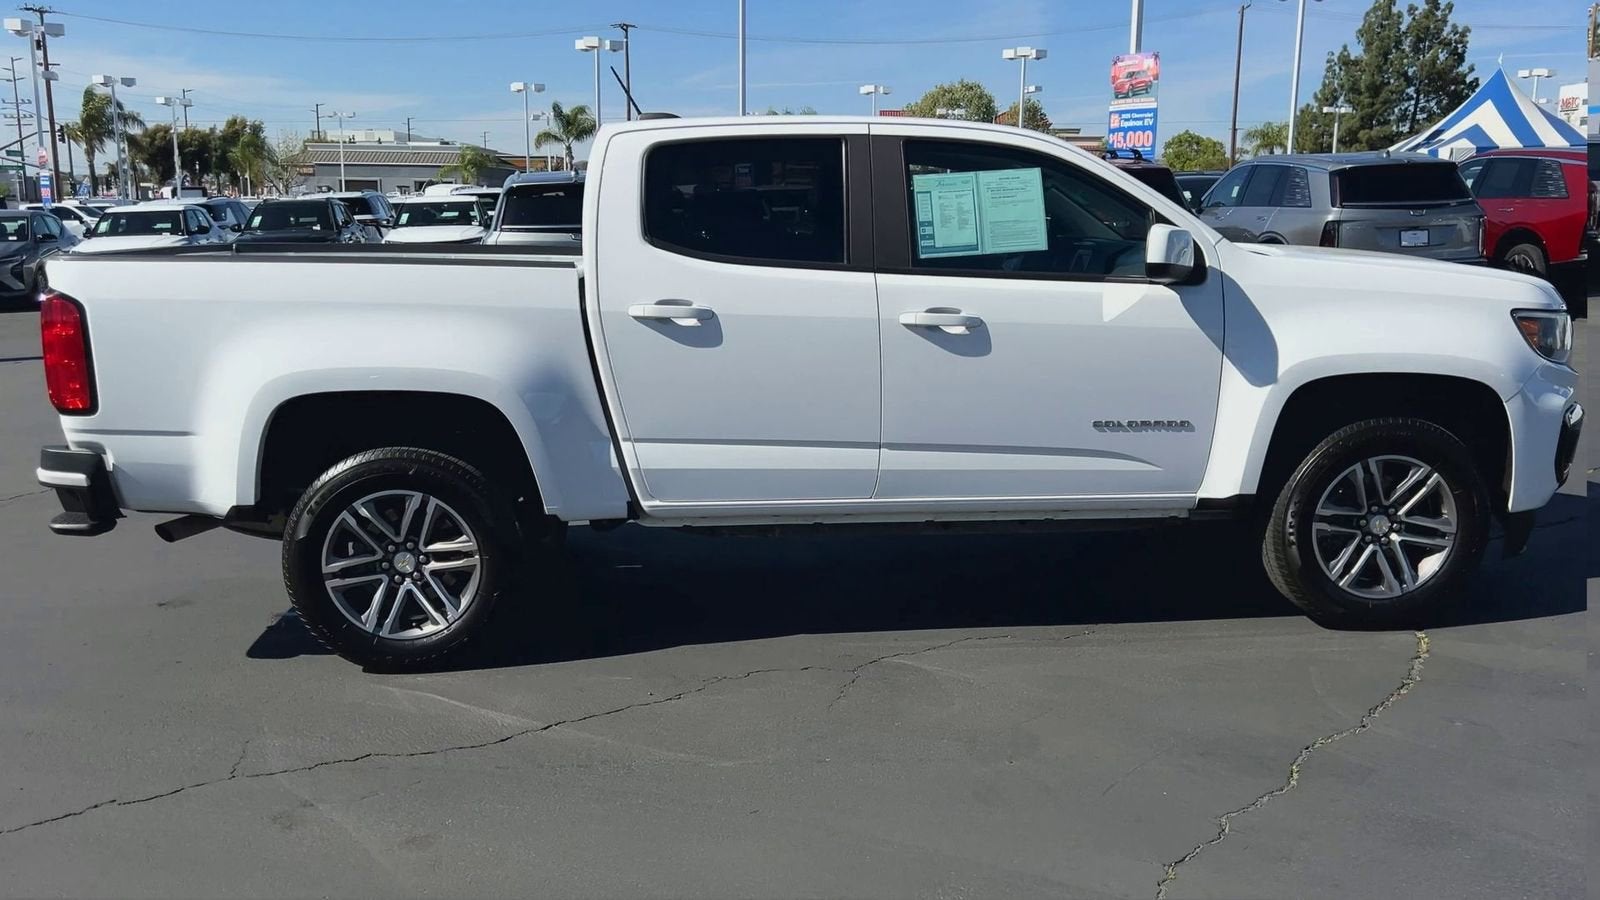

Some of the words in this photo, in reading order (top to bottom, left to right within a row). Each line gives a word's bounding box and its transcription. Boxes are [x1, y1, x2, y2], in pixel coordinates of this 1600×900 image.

[1120, 119, 1143, 128] Equinox
[1144, 118, 1154, 126] EV
[1109, 130, 1153, 149] $15,000
[1092, 420, 1195, 433] COLORADO
